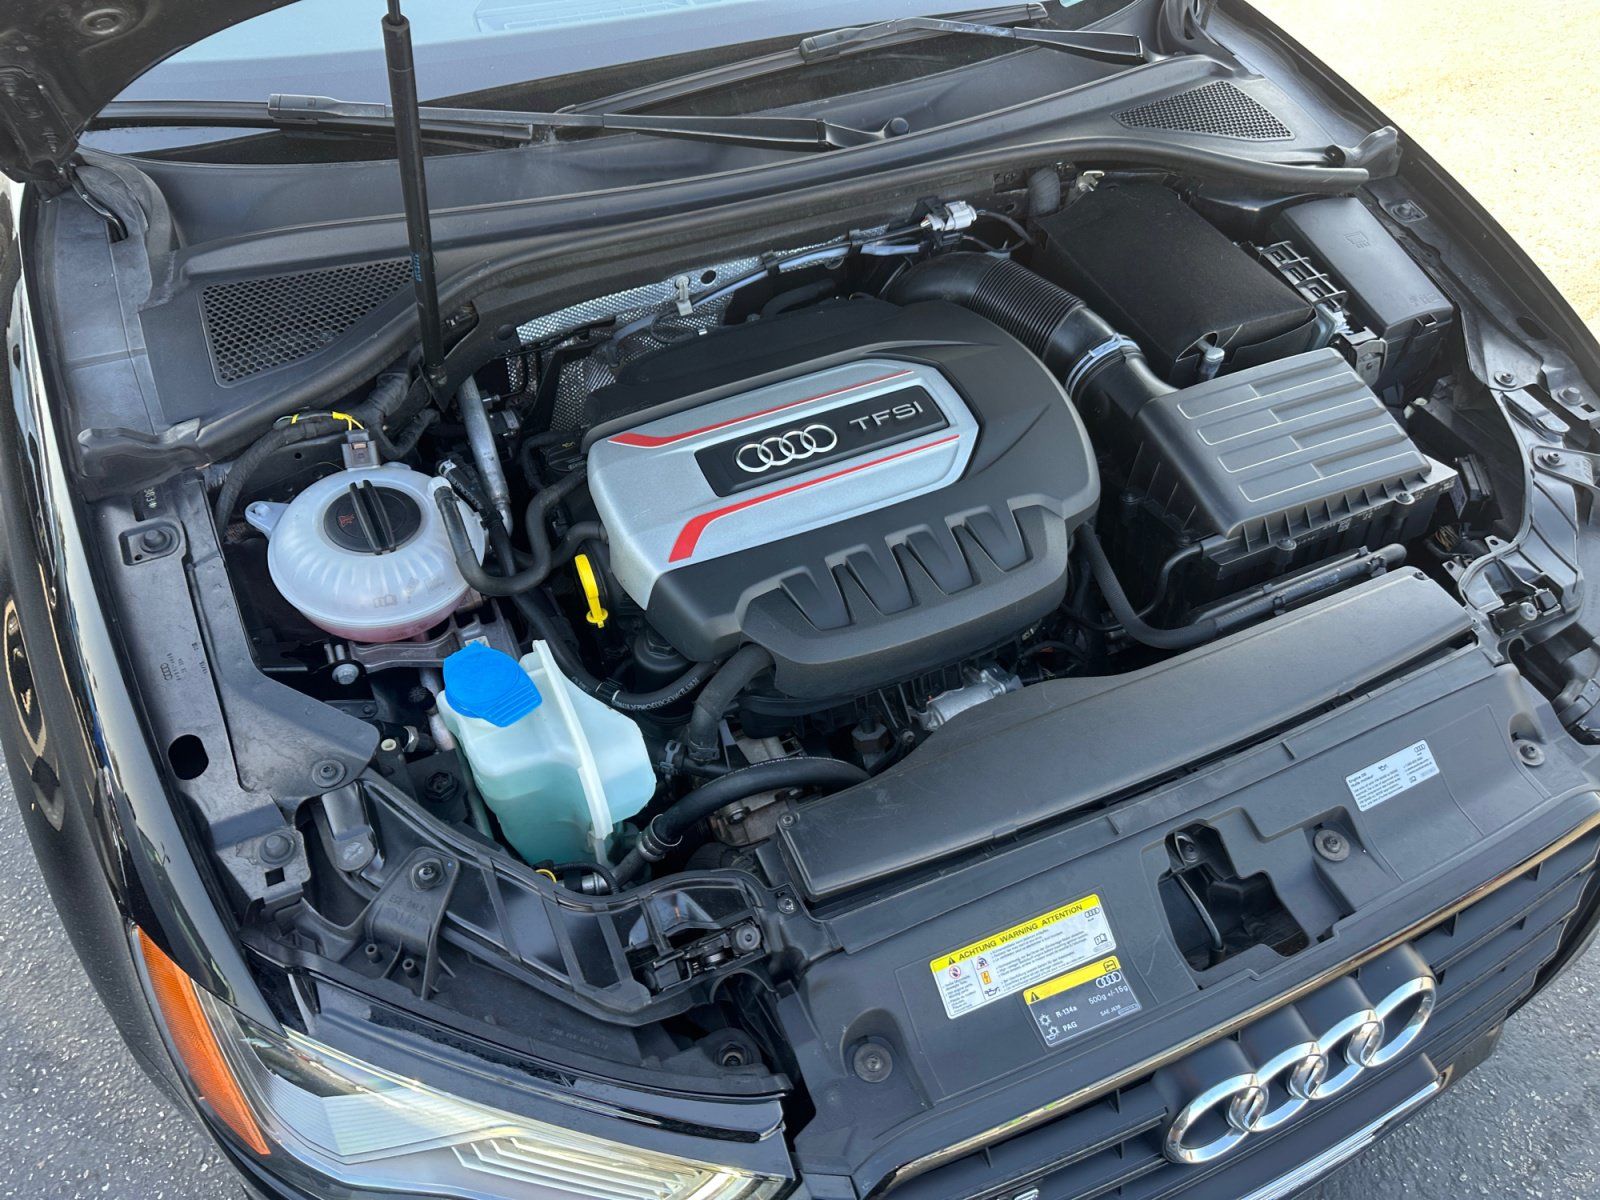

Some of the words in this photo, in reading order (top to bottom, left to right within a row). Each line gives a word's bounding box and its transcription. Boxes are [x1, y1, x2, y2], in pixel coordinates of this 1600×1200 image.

[849, 400, 924, 430] TFSI
[958, 940, 997, 961] ACHTUNG
[999, 923, 1038, 943] WARNING
[1041, 904, 1083, 926] ATTENTION
[1055, 1006, 1078, 1018] R-134a
[1062, 1021, 1078, 1032] PAG
